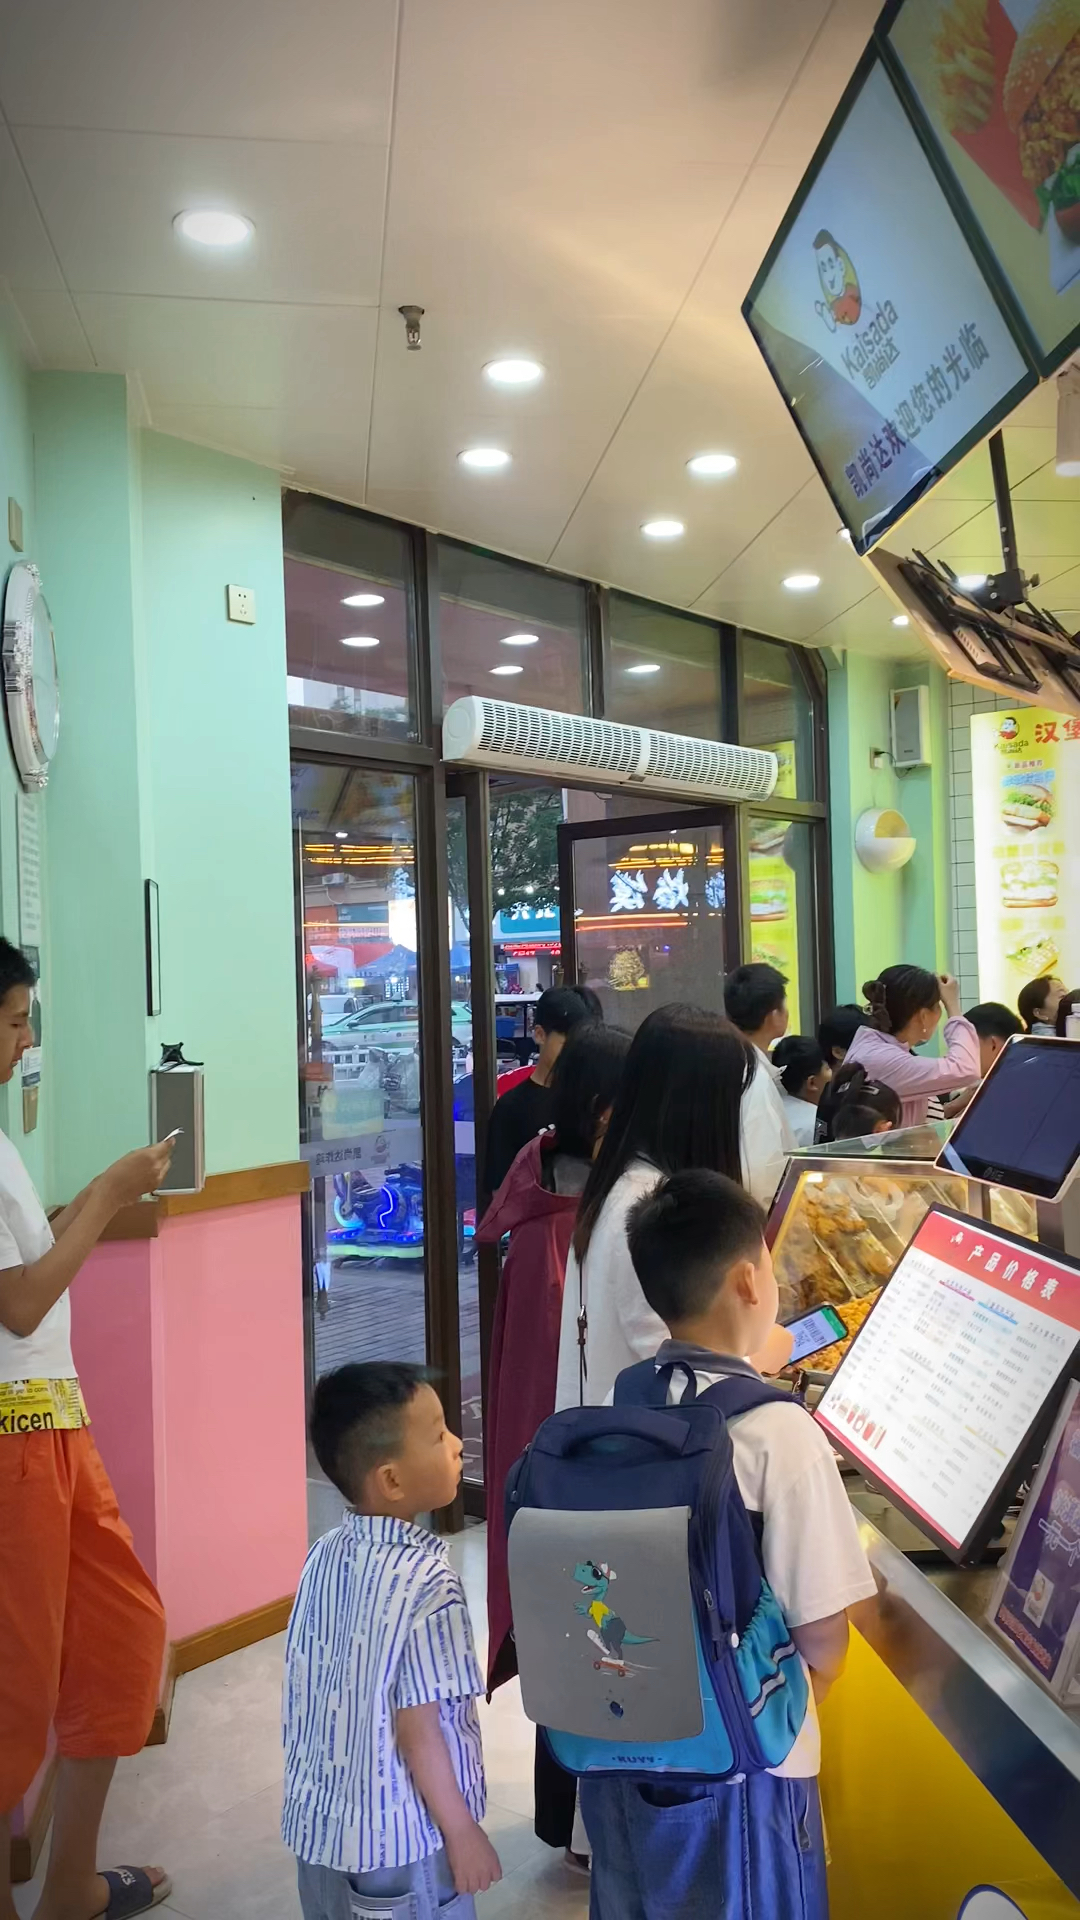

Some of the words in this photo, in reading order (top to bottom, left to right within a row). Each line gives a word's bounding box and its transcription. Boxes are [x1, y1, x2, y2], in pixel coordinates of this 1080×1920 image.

[841, 299, 899, 380] Kaisada
[844, 321, 990, 499] 凯尚达欢迎您的光临
[966, 1243, 1060, 1301] 产品价格表
